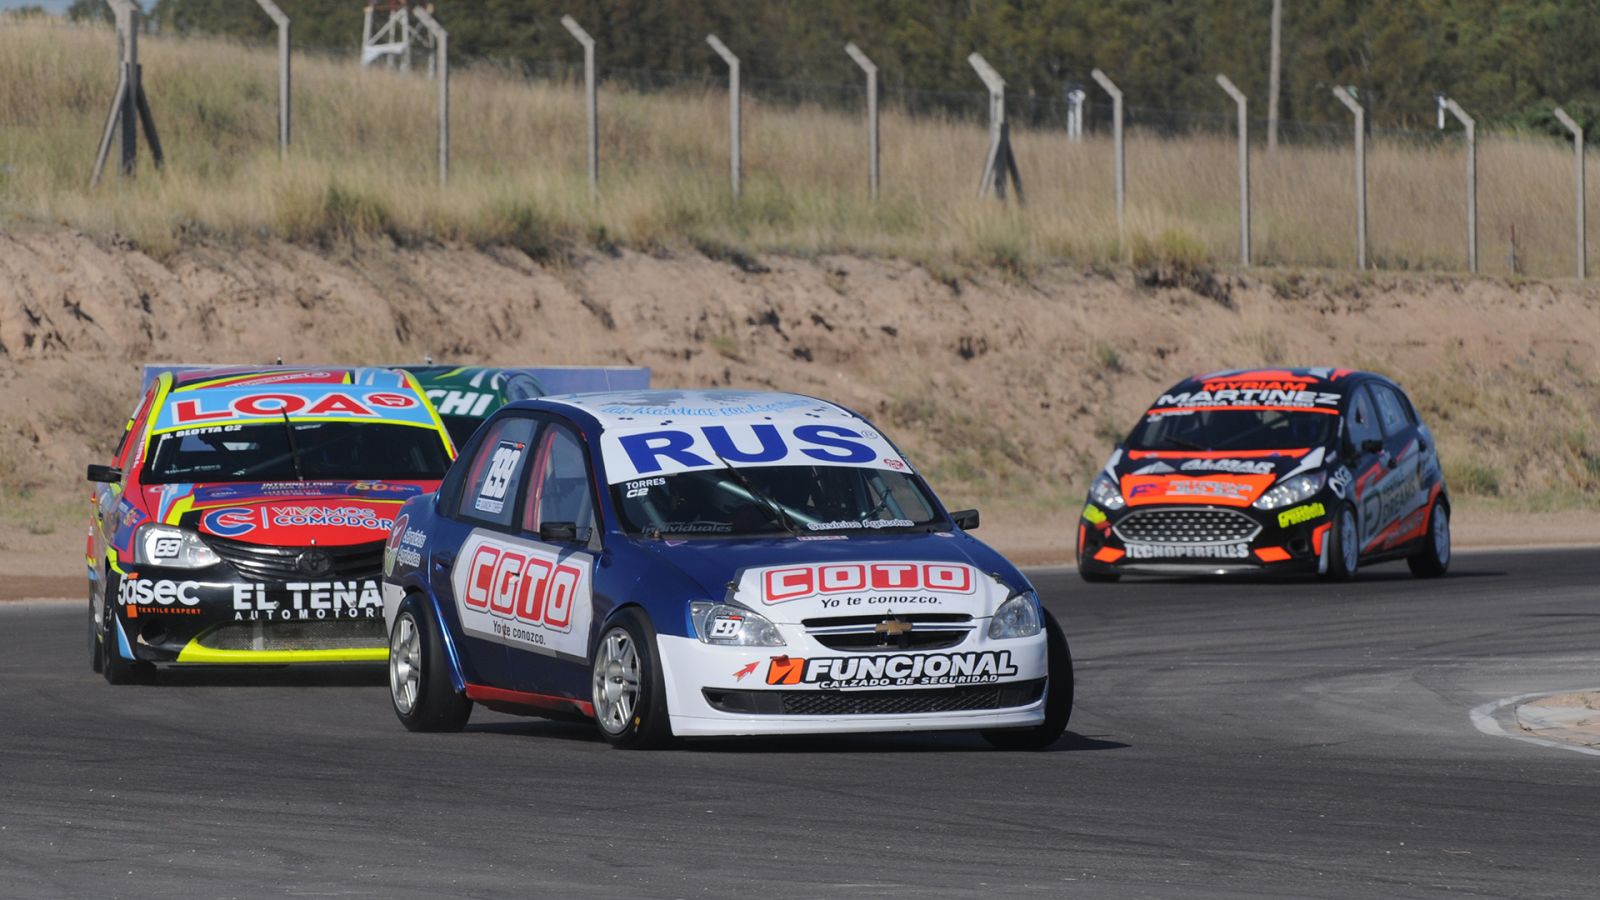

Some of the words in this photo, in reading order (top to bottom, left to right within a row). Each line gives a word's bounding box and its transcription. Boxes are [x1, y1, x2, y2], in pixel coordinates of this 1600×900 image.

[1157, 388, 1342, 406] MARTINEZ
[1203, 381, 1308, 392] MYRIAM
[174, 393, 376, 425] LOA
[618, 424, 877, 474] RUS
[626, 478, 666, 490] TORRES
[626, 488, 649, 499] C2
[272, 506, 376, 518] VIVAMOS
[155, 539, 180, 557] 89
[118, 572, 201, 606] 5asec
[465, 546, 581, 628] COTO
[766, 564, 971, 601] COTO
[233, 583, 280, 610] EL
[822, 599, 840, 608] Yo
[847, 597, 862, 606] te
[868, 595, 943, 605] conozco.
[493, 620, 502, 634] Yo
[512, 627, 546, 646] conozco.
[806, 653, 1014, 681] FUNCIONAL
[820, 678, 889, 688] CALZADO
[899, 677, 914, 686] DE
[921, 674, 997, 686] SEGURIDAD
